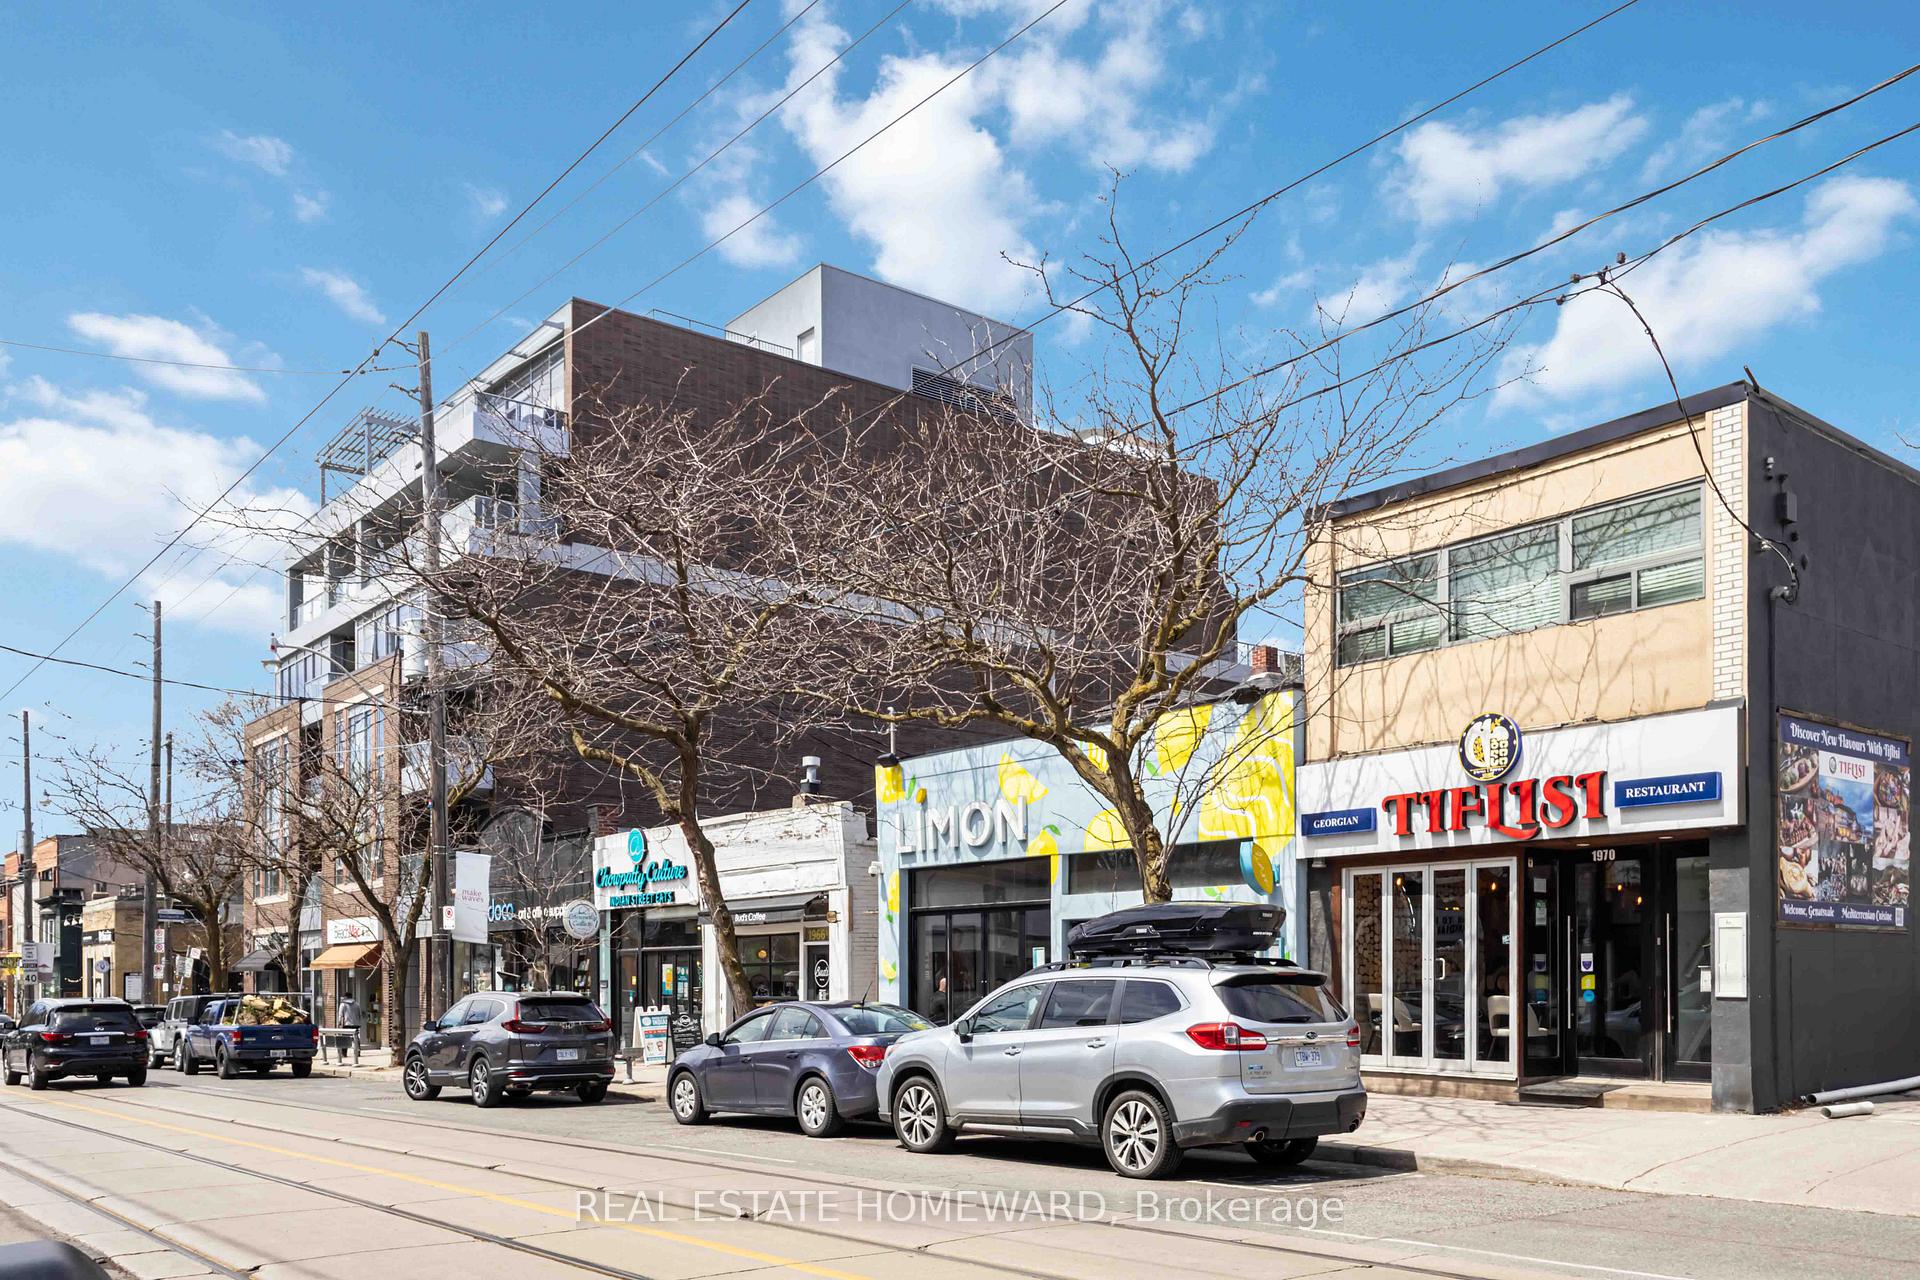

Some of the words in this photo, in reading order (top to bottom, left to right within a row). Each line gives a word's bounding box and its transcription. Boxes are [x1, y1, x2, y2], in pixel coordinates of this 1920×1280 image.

[1790, 722, 1820, 742] Discover
[1821, 730, 1837, 746] New
[1838, 734, 1866, 752] Flavours
[1867, 740, 1883, 757] With
[1884, 744, 1900, 761] Tiflisi
[1626, 781, 1706, 798] RESTAURANT
[1382, 770, 1608, 840] TIFLISI
[896, 795, 1027, 853] LIMON
[1314, 816, 1359, 829] GEORGIAN
[1591, 849, 1616, 862] 1970
[646, 859, 688, 882] Culture
[461, 894, 484, 902] waves
[462, 888, 482, 897] make
[610, 895, 630, 907] INDIAN
[630, 892, 654, 906] STREET
[655, 891, 674, 904] EATS
[748, 912, 766, 921] Coffee
[1876, 910, 1892, 921] Cuisine
[25, 974, 37, 982] 40
